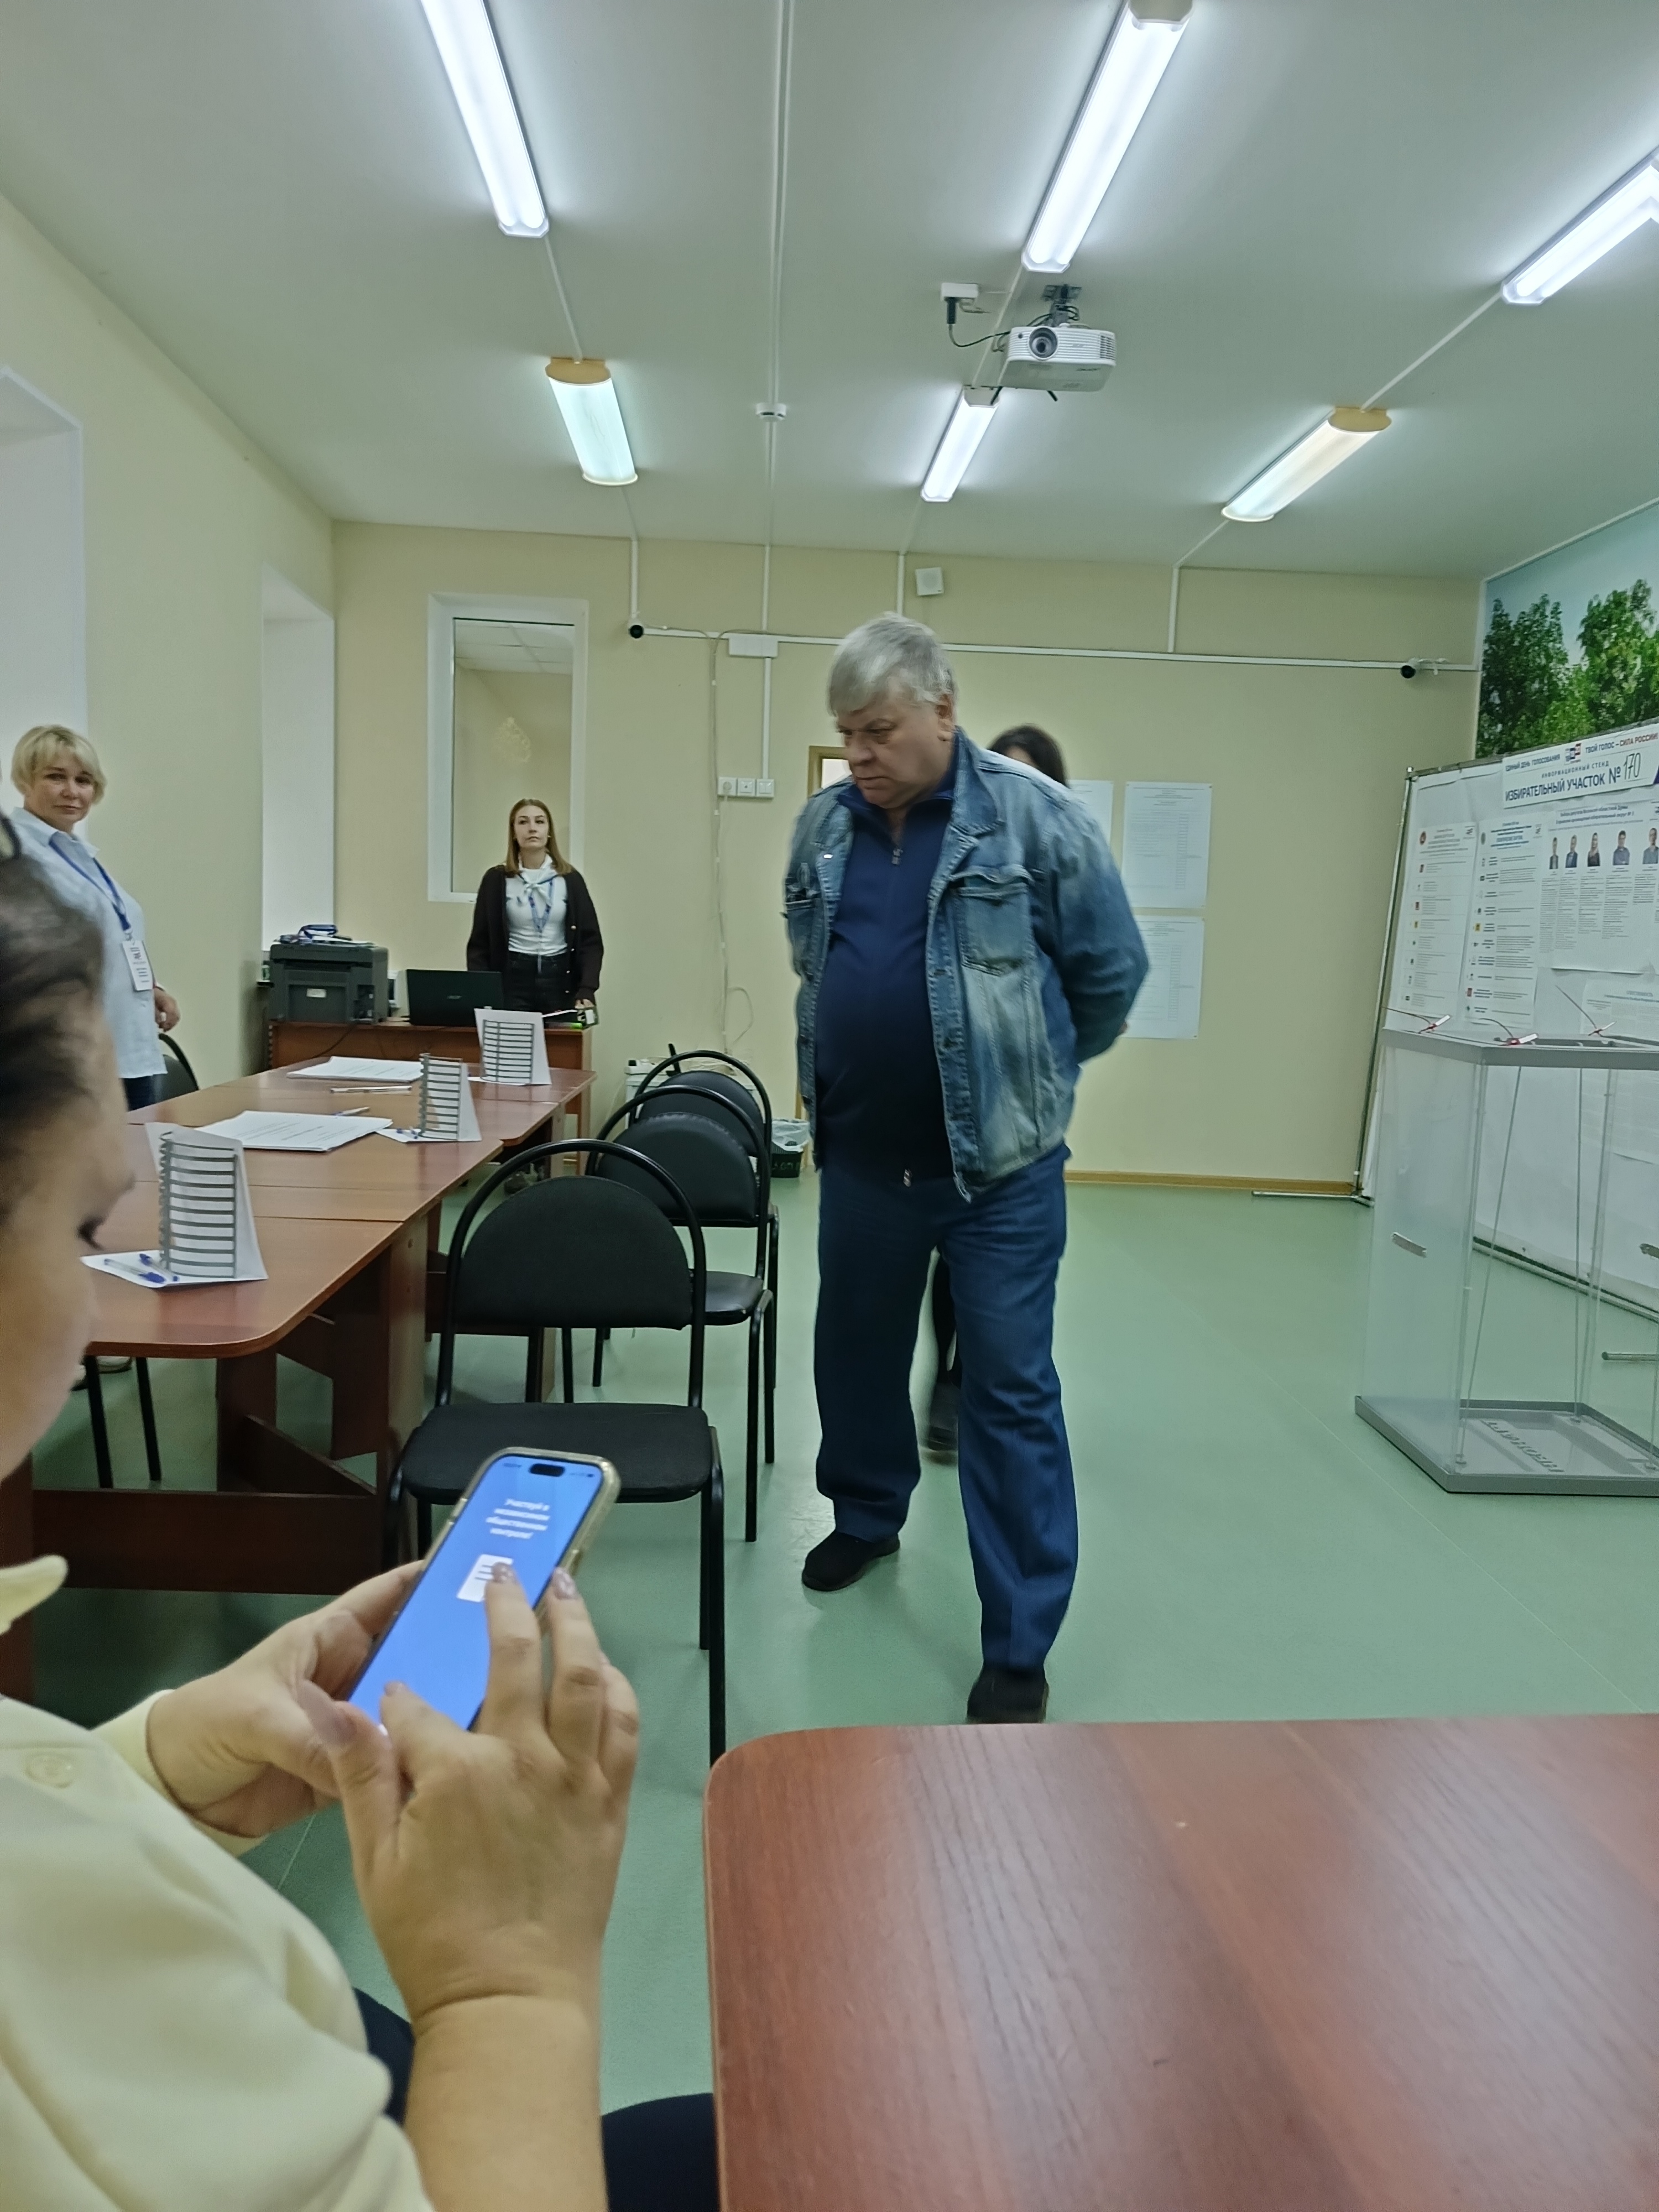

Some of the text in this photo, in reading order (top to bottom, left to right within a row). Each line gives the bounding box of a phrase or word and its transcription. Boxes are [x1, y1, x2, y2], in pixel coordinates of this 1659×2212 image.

[1585, 743, 1598, 753] ТВОЙ
[1599, 742, 1614, 751] ГОЛОС
[1620, 738, 1634, 747] СИЛА
[1532, 754, 1561, 765] ГОЛОСОВАНИЯ
[1505, 753, 1641, 801] ИЗБИРАТЕЛЬНЫЙ УЧАСТОК № 170
[1541, 760, 1609, 778] ИНФОРМАЦИОННЫЙ СТЕНД
